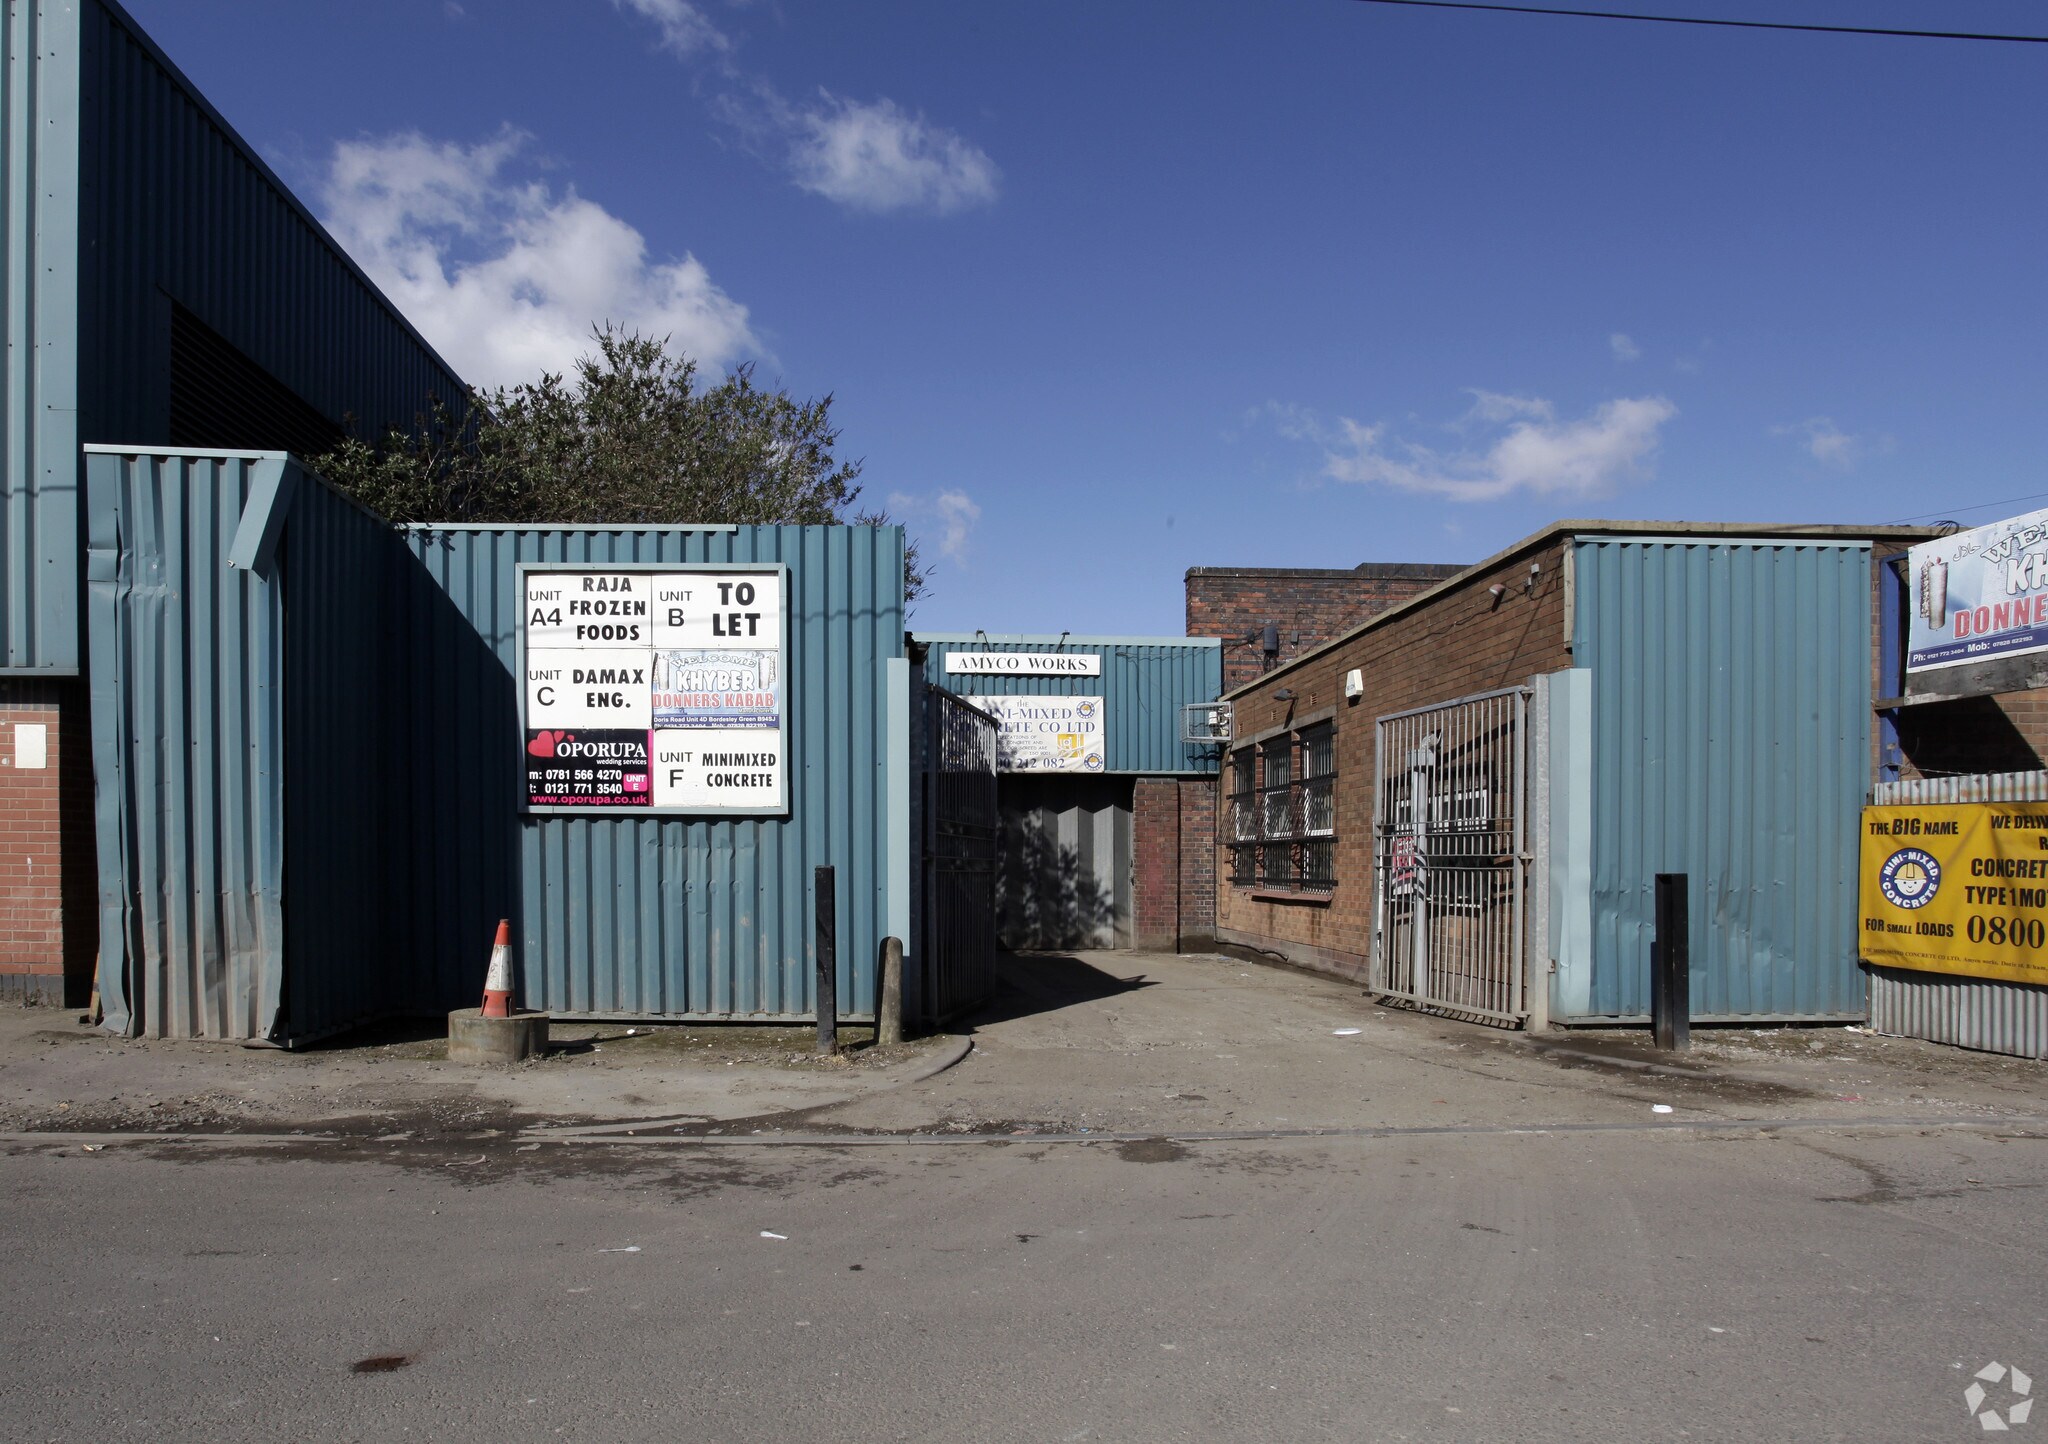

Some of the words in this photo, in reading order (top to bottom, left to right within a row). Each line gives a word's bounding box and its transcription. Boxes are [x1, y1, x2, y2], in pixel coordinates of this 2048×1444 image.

[582, 577, 632, 592] RAJA
[529, 591, 562, 601] UNIT
[660, 591, 693, 601] UNIT
[717, 582, 755, 606] TO
[569, 600, 646, 616] FROZEN
[530, 608, 563, 626] A4
[668, 608, 685, 627] B
[1954, 593, 2048, 639] DONNE
[713, 613, 761, 636] LET
[577, 625, 640, 641] FOODS
[1912, 653, 1926, 663] Ph:
[1967, 641, 1990, 653] Mob:
[670, 654, 757, 668] WELCOME
[958, 656, 1019, 670] AMYCO
[1028, 657, 1088, 671] WORKS
[529, 670, 562, 681] UNIT
[572, 669, 644, 684] DAMAX
[676, 669, 754, 692] KHYBER
[537, 686, 555, 706] C
[586, 692, 631, 708] ENG.
[653, 693, 720, 709] DONNERS
[724, 693, 775, 708] KABAB
[982, 708, 1072, 719] INI-MIXED
[1039, 722, 1060, 733] CO
[1067, 721, 1095, 733] LTD
[557, 742, 647, 758] OPORUPA
[660, 752, 693, 763] UNIT
[596, 758, 622, 766] wedding
[702, 753, 777, 766] MINIMIXED
[1016, 758, 1037, 769] 212
[1043, 758, 1065, 769] 082
[529, 771, 542, 780] m:
[545, 769, 570, 780] 0781
[574, 769, 594, 780] 566
[596, 769, 622, 780] 4270
[626, 774, 646, 782] UNIT
[670, 769, 684, 788] F
[706, 773, 772, 787] CONCRETE
[529, 784, 537, 793] t:
[545, 783, 570, 794] 0121
[574, 783, 592, 794] 771
[597, 783, 623, 794] 3540
[530, 794, 647, 806] www.oporupa.co.uk
[1869, 822, 1890, 835] THE
[1892, 818, 1921, 836] BIG
[1924, 821, 1959, 835] NAME
[1991, 815, 2010, 829] WE
[1883, 851, 1940, 876] MINI-MIXED
[1882, 881, 1939, 908] CONCRETE
[1965, 885, 2006, 906] TYPE
[2009, 887, 2017, 906] 1
[2019, 888, 2048, 909] MO
[1865, 918, 1885, 932] FOR
[1886, 924, 1912, 935] SMALL
[1915, 922, 1954, 937] LOADS
[1967, 915, 2045, 949] 0800
[1904, 951, 1936, 960] CONCRETE
